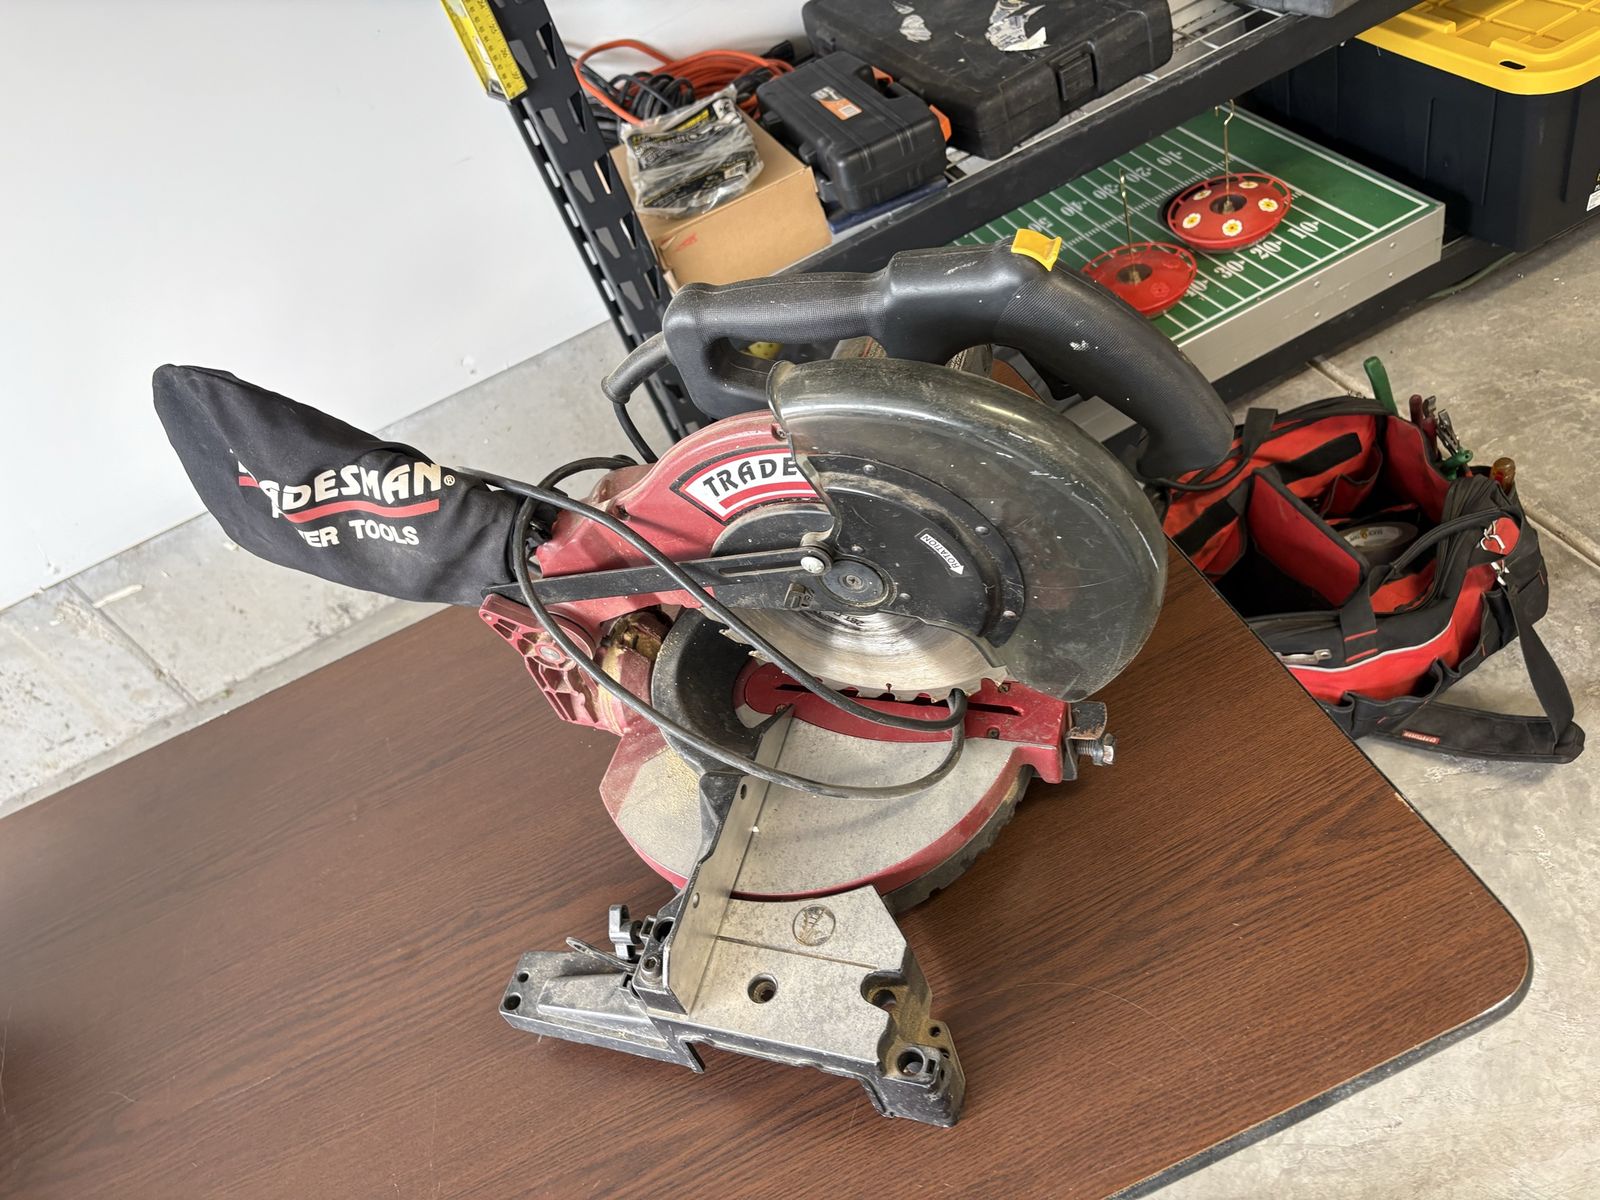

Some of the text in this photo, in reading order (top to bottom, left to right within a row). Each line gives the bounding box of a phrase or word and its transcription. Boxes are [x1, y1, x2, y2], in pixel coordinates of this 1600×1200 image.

[1286, 220, 1319, 240] 10
[1250, 240, 1282, 260] 20
[1214, 259, 1245, 279] 30
[349, 519, 420, 546] TOOLS
[922, 535, 960, 569] ROTATION
